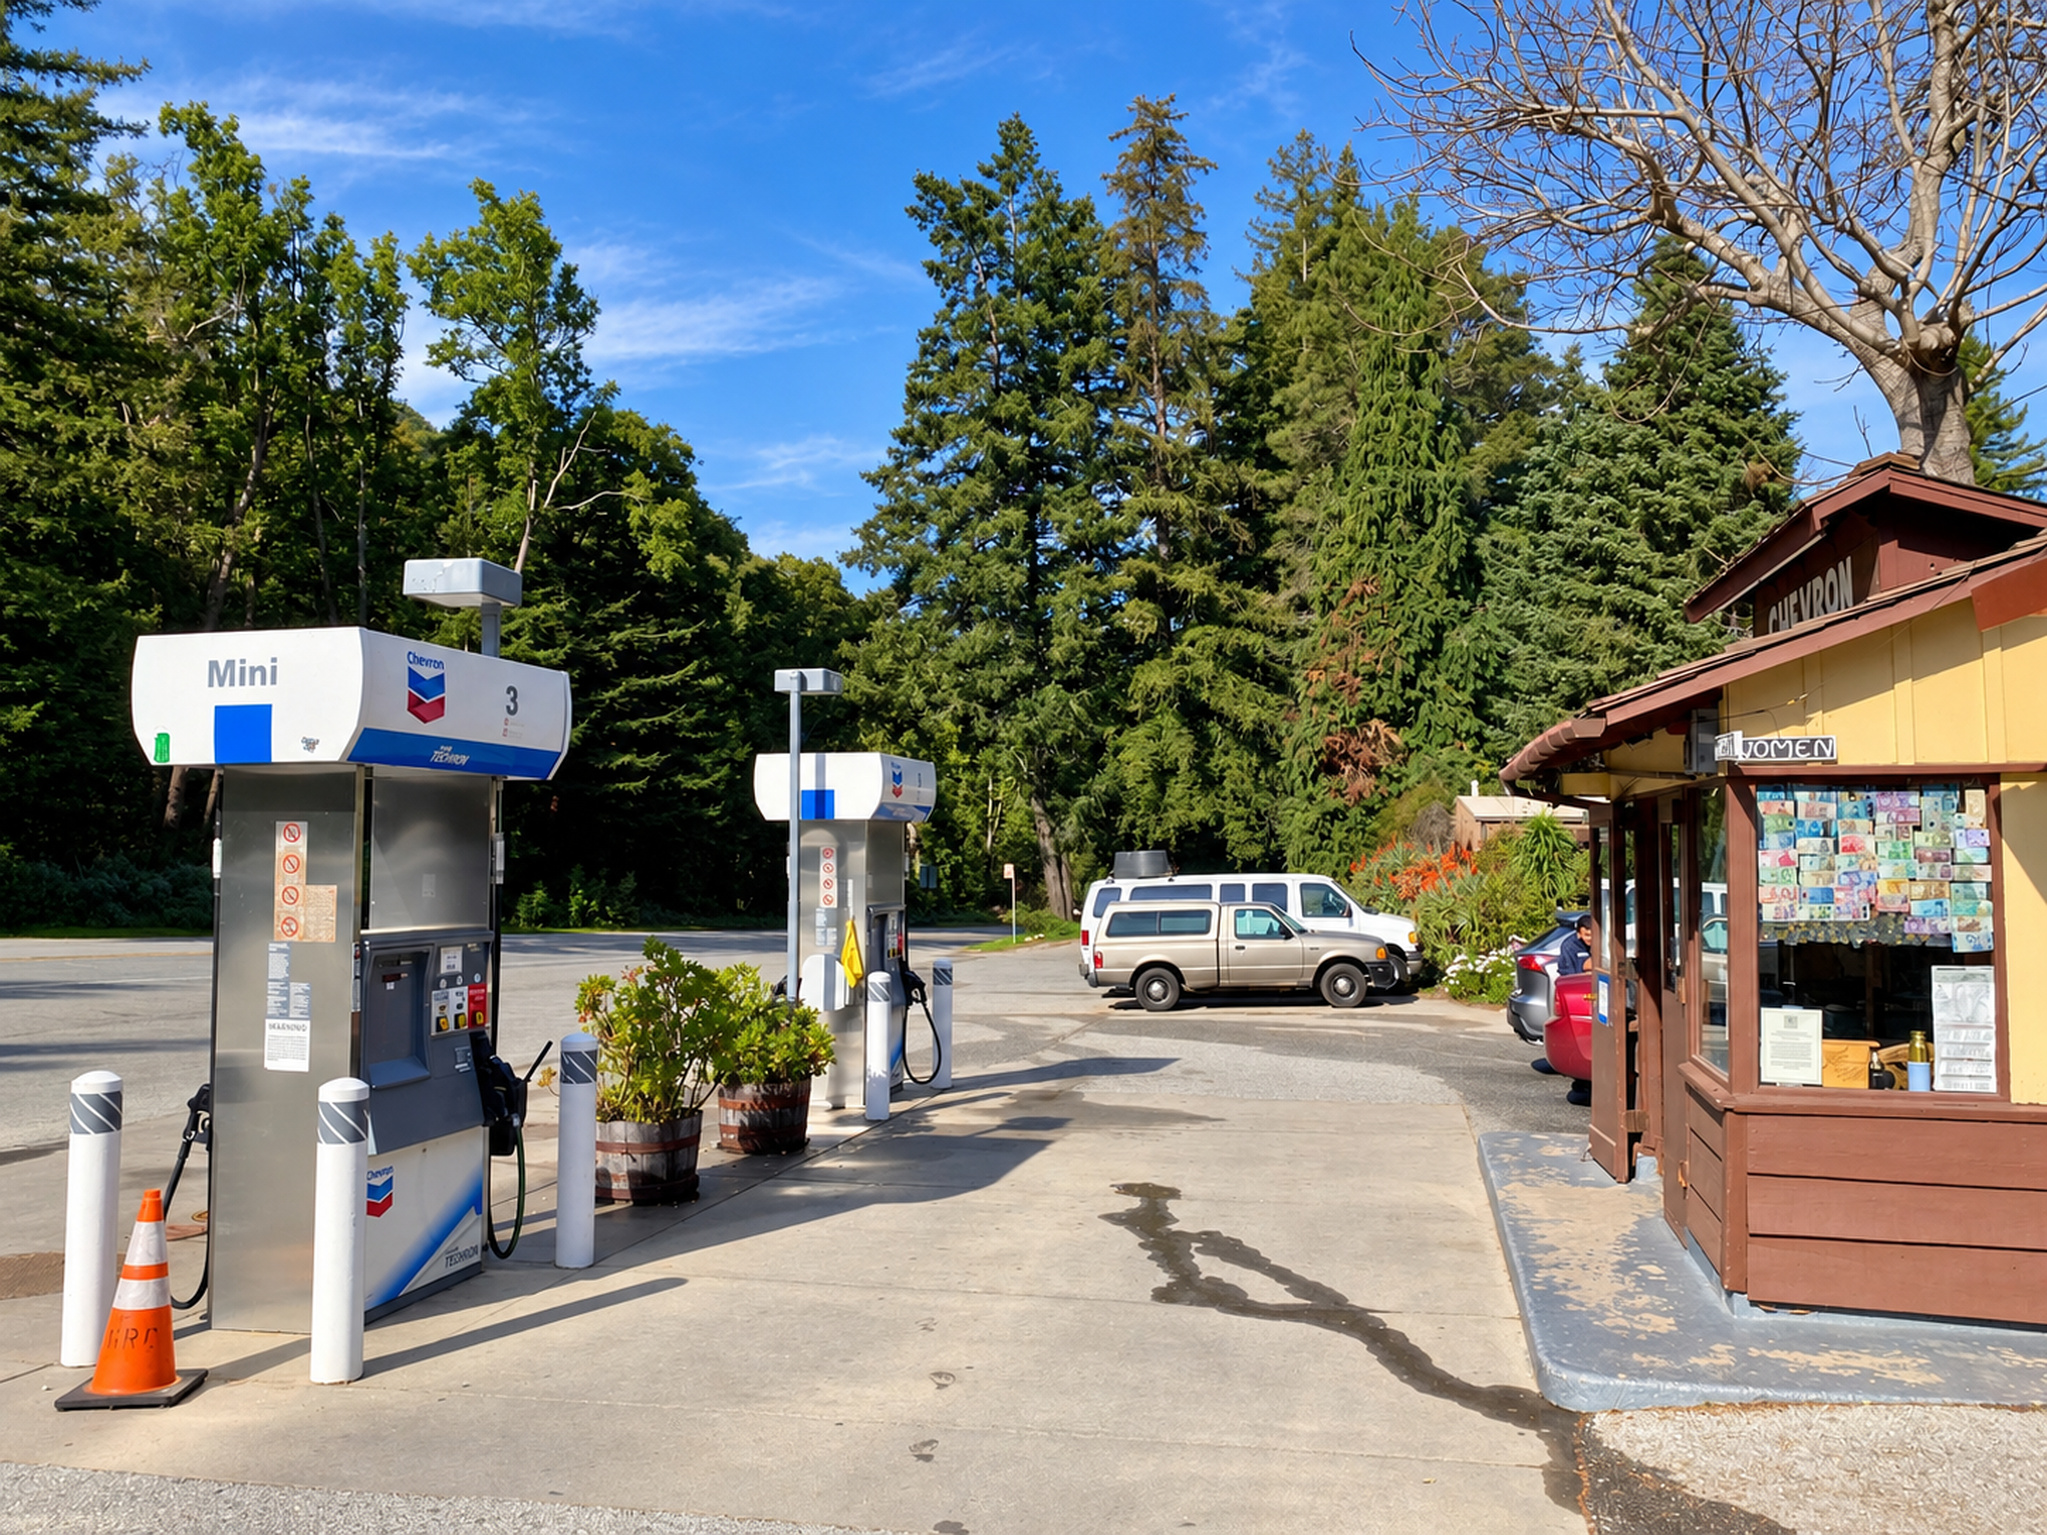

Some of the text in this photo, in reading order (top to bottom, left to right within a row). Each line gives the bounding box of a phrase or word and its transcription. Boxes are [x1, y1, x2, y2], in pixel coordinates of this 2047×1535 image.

[1768, 555, 1854, 634] CHEVRON
[208, 657, 278, 687] Mini
[407, 651, 445, 670] Chevron
[506, 686, 519, 716] 3
